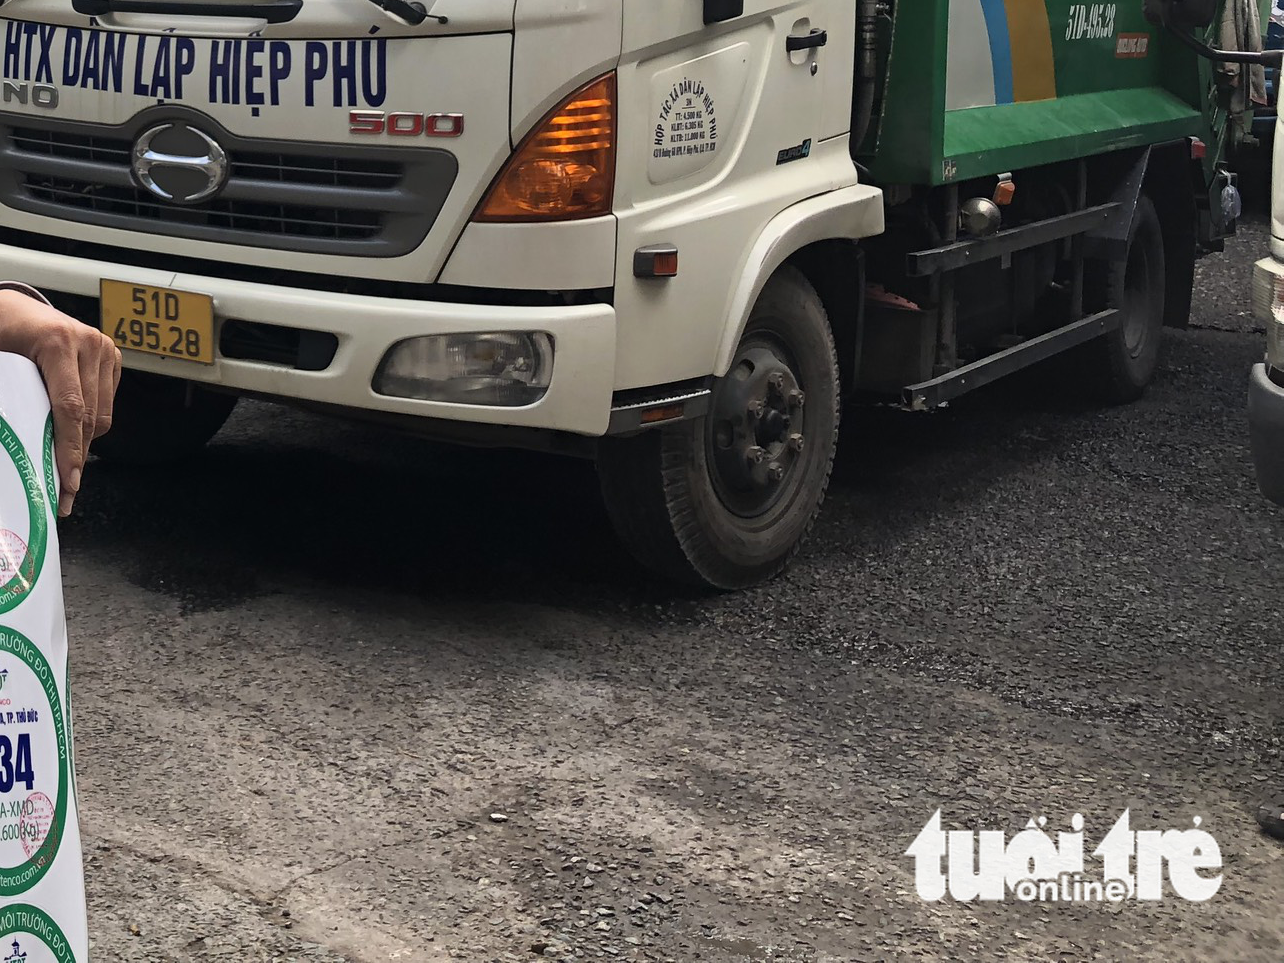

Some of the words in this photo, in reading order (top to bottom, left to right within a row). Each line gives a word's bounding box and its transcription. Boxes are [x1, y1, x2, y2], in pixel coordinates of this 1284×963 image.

[1065, 3, 1116, 41] 51D-495.28
[3, 21, 57, 83] HTX
[62, 16, 127, 93] DÂN
[134, 27, 196, 105] LẬP
[209, 31, 292, 117] HIỆP
[304, 24, 387, 107] PHÚ
[349, 109, 464, 137] 500
[131, 288, 179, 321] 51D
[113, 317, 201, 357] 495.28
[2, 429, 18, 453] THỊ
[34, 658, 48, 680] ĐÔ
[6, 712, 15, 724] TP.
[16, 707, 27, 723] THỦ
[27, 707, 38, 723] ĐỨC
[16, 912, 53, 941] TRƯỜNG
[52, 934, 66, 956] ĐÔ
